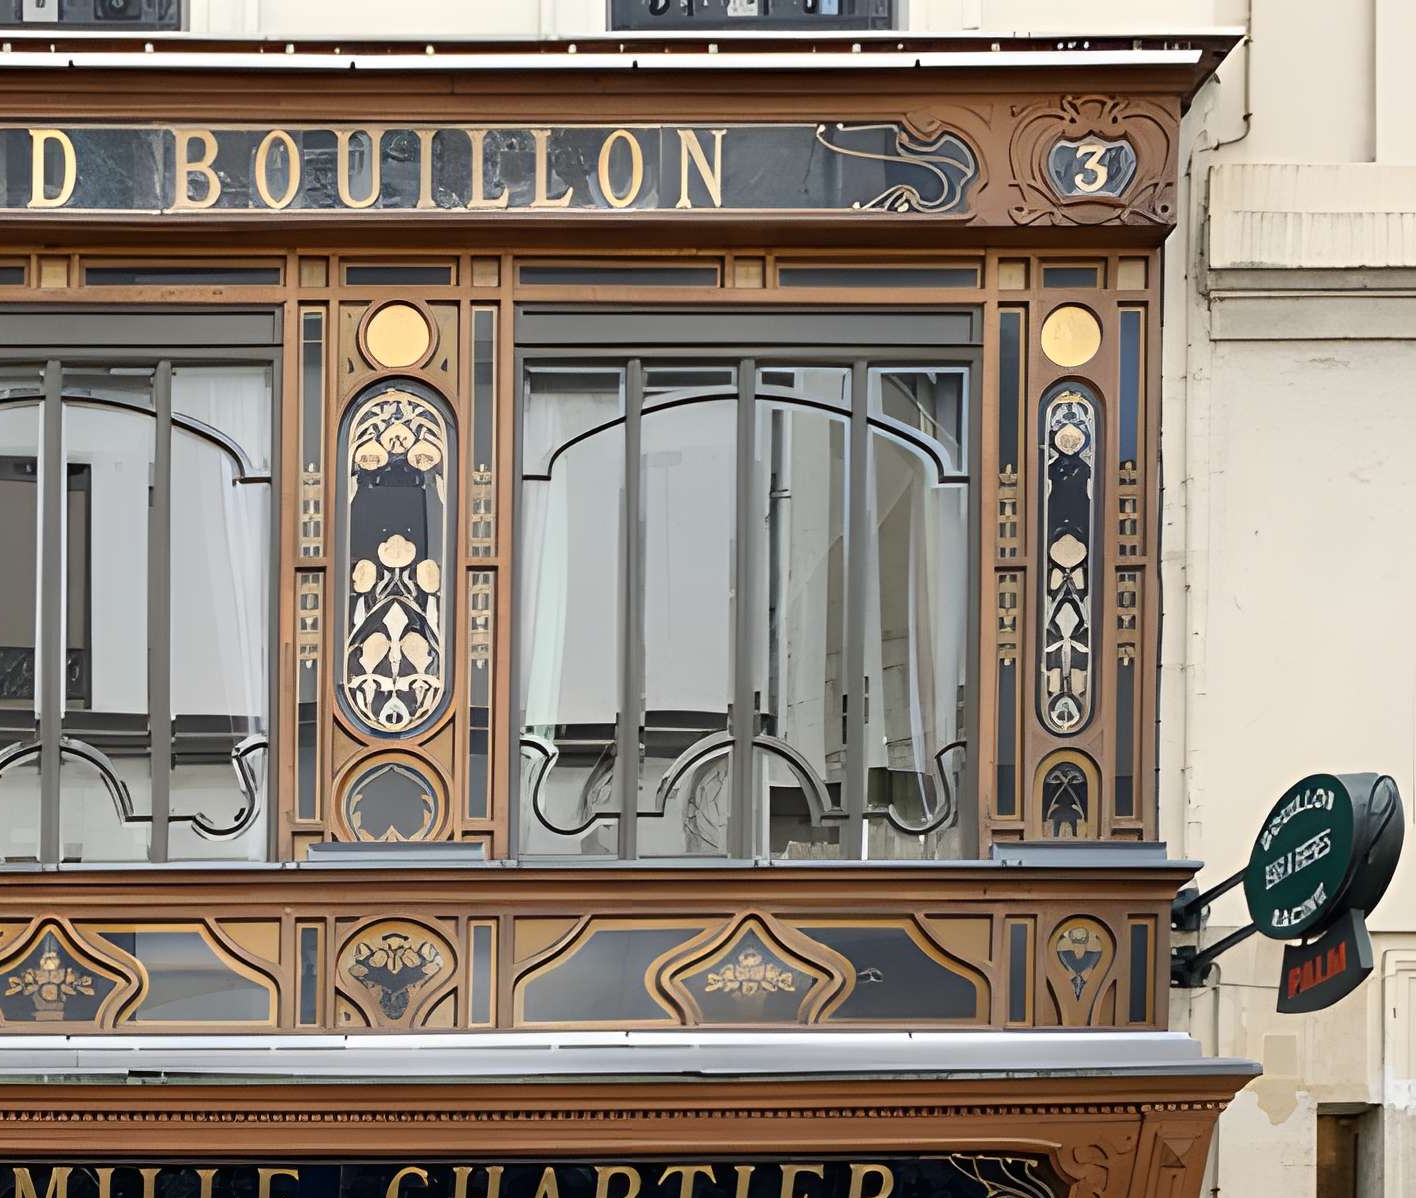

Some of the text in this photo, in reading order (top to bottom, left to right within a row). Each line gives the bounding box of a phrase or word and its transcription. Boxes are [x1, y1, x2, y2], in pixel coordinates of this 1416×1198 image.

[173, 124, 728, 210] BOUILLON
[1074, 144, 1108, 193] 3
[1287, 942, 1347, 999] PALM
